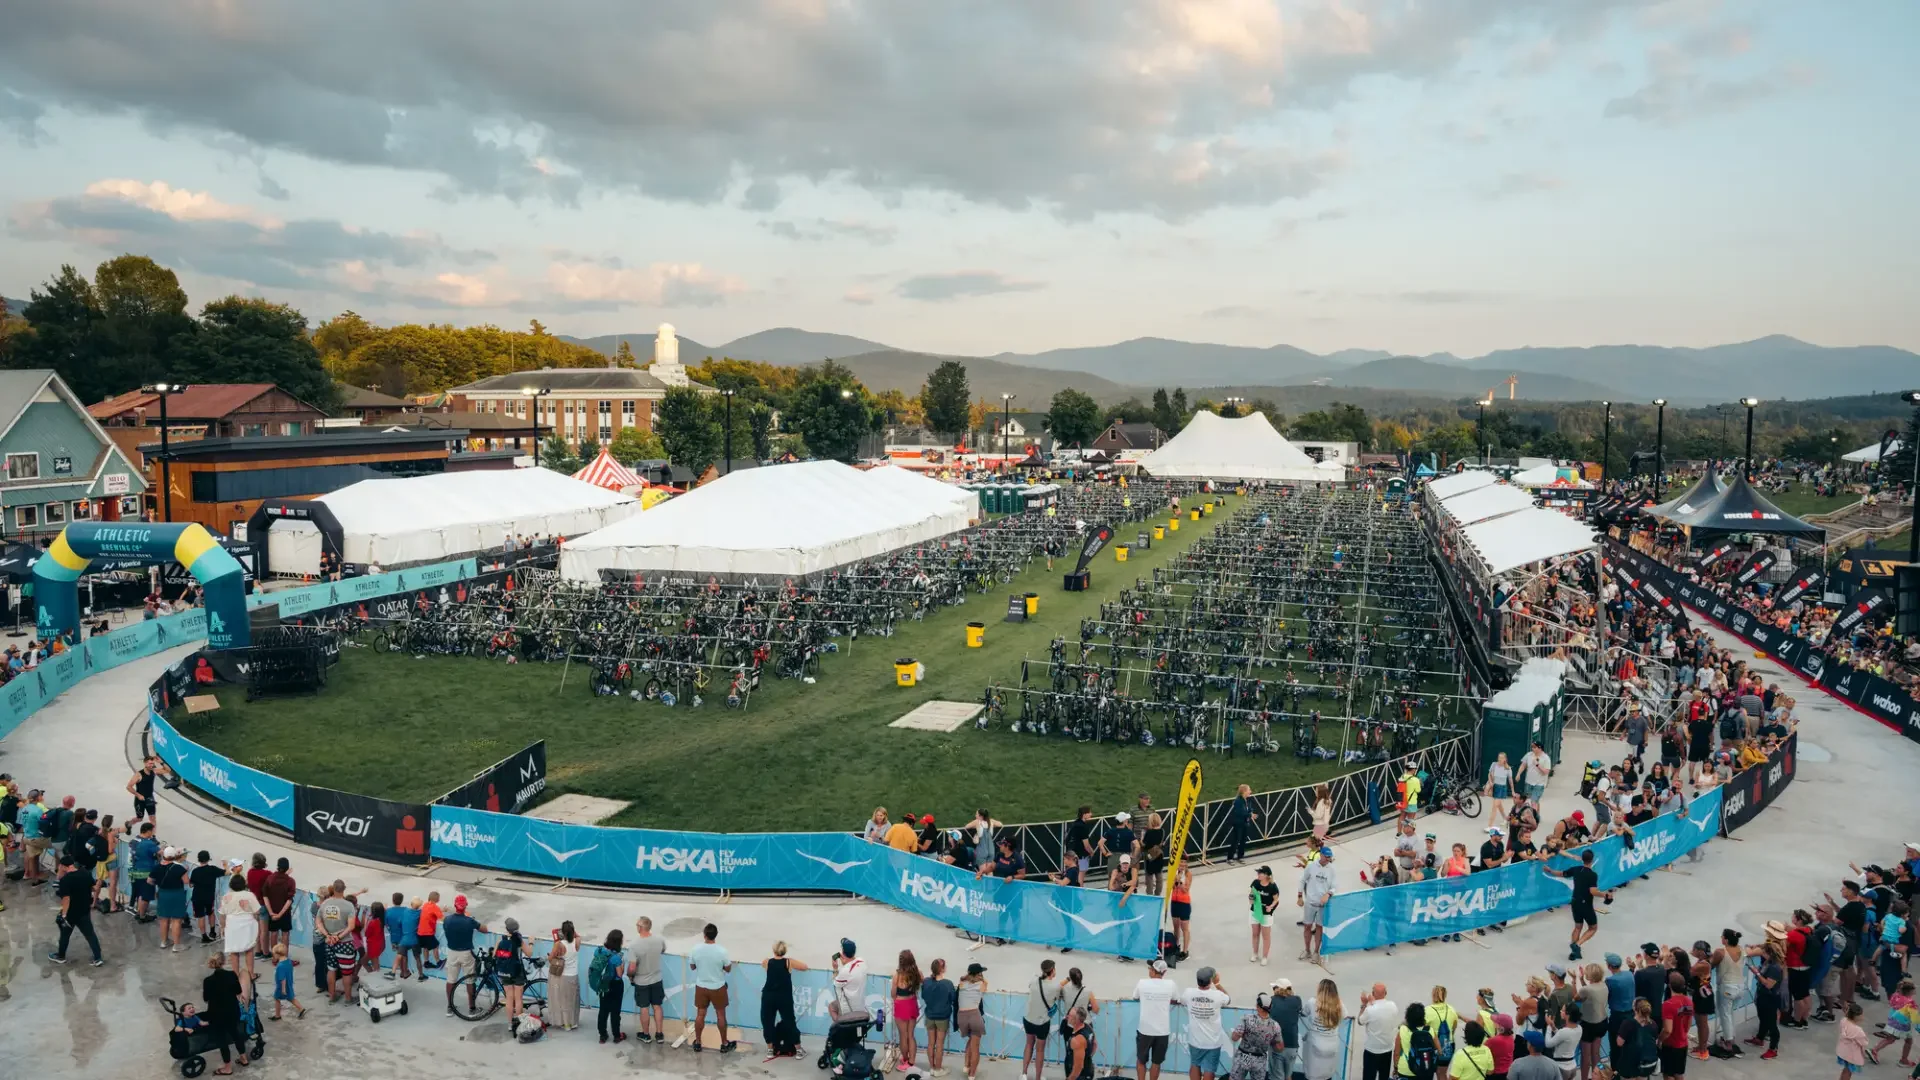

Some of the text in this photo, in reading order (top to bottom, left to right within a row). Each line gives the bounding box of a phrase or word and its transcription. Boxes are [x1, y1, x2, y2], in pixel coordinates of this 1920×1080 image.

[94, 528, 152, 542] ATHLETIC
[101, 544, 131, 552] BREWING
[118, 560, 141, 569] Hyperice
[355, 580, 380, 592] ATHLETIC
[284, 593, 311, 606] ATHLETIC
[377, 599, 409, 614] QATAR
[110, 634, 139, 651] ATHLETIC
[1873, 694, 1901, 715] wahoo
[199, 758, 225, 789] HOKA
[1768, 761, 1782, 788] HOKA
[515, 778, 546, 804] MAURTEN
[1724, 789, 1745, 818] HOKA
[464, 824, 478, 832] FLY
[1168, 796, 1194, 867] CROSSWALK
[464, 832, 495, 844] HUMAN
[464, 839, 478, 849] FLY
[636, 846, 717, 873] HOKA
[719, 850, 735, 858] FLY
[1619, 834, 1660, 872] HOKA
[719, 857, 757, 866] HUMAN
[719, 865, 735, 874] FLY
[901, 869, 968, 914] HOKA
[969, 889, 984, 900] FLY
[1487, 883, 1500, 893] FLY
[1487, 888, 1516, 901] HUMAN
[969, 898, 1007, 913] HUMAN
[1410, 887, 1486, 924] HOKA
[1486, 899, 1498, 910] FLY
[969, 907, 983, 918] FLY
